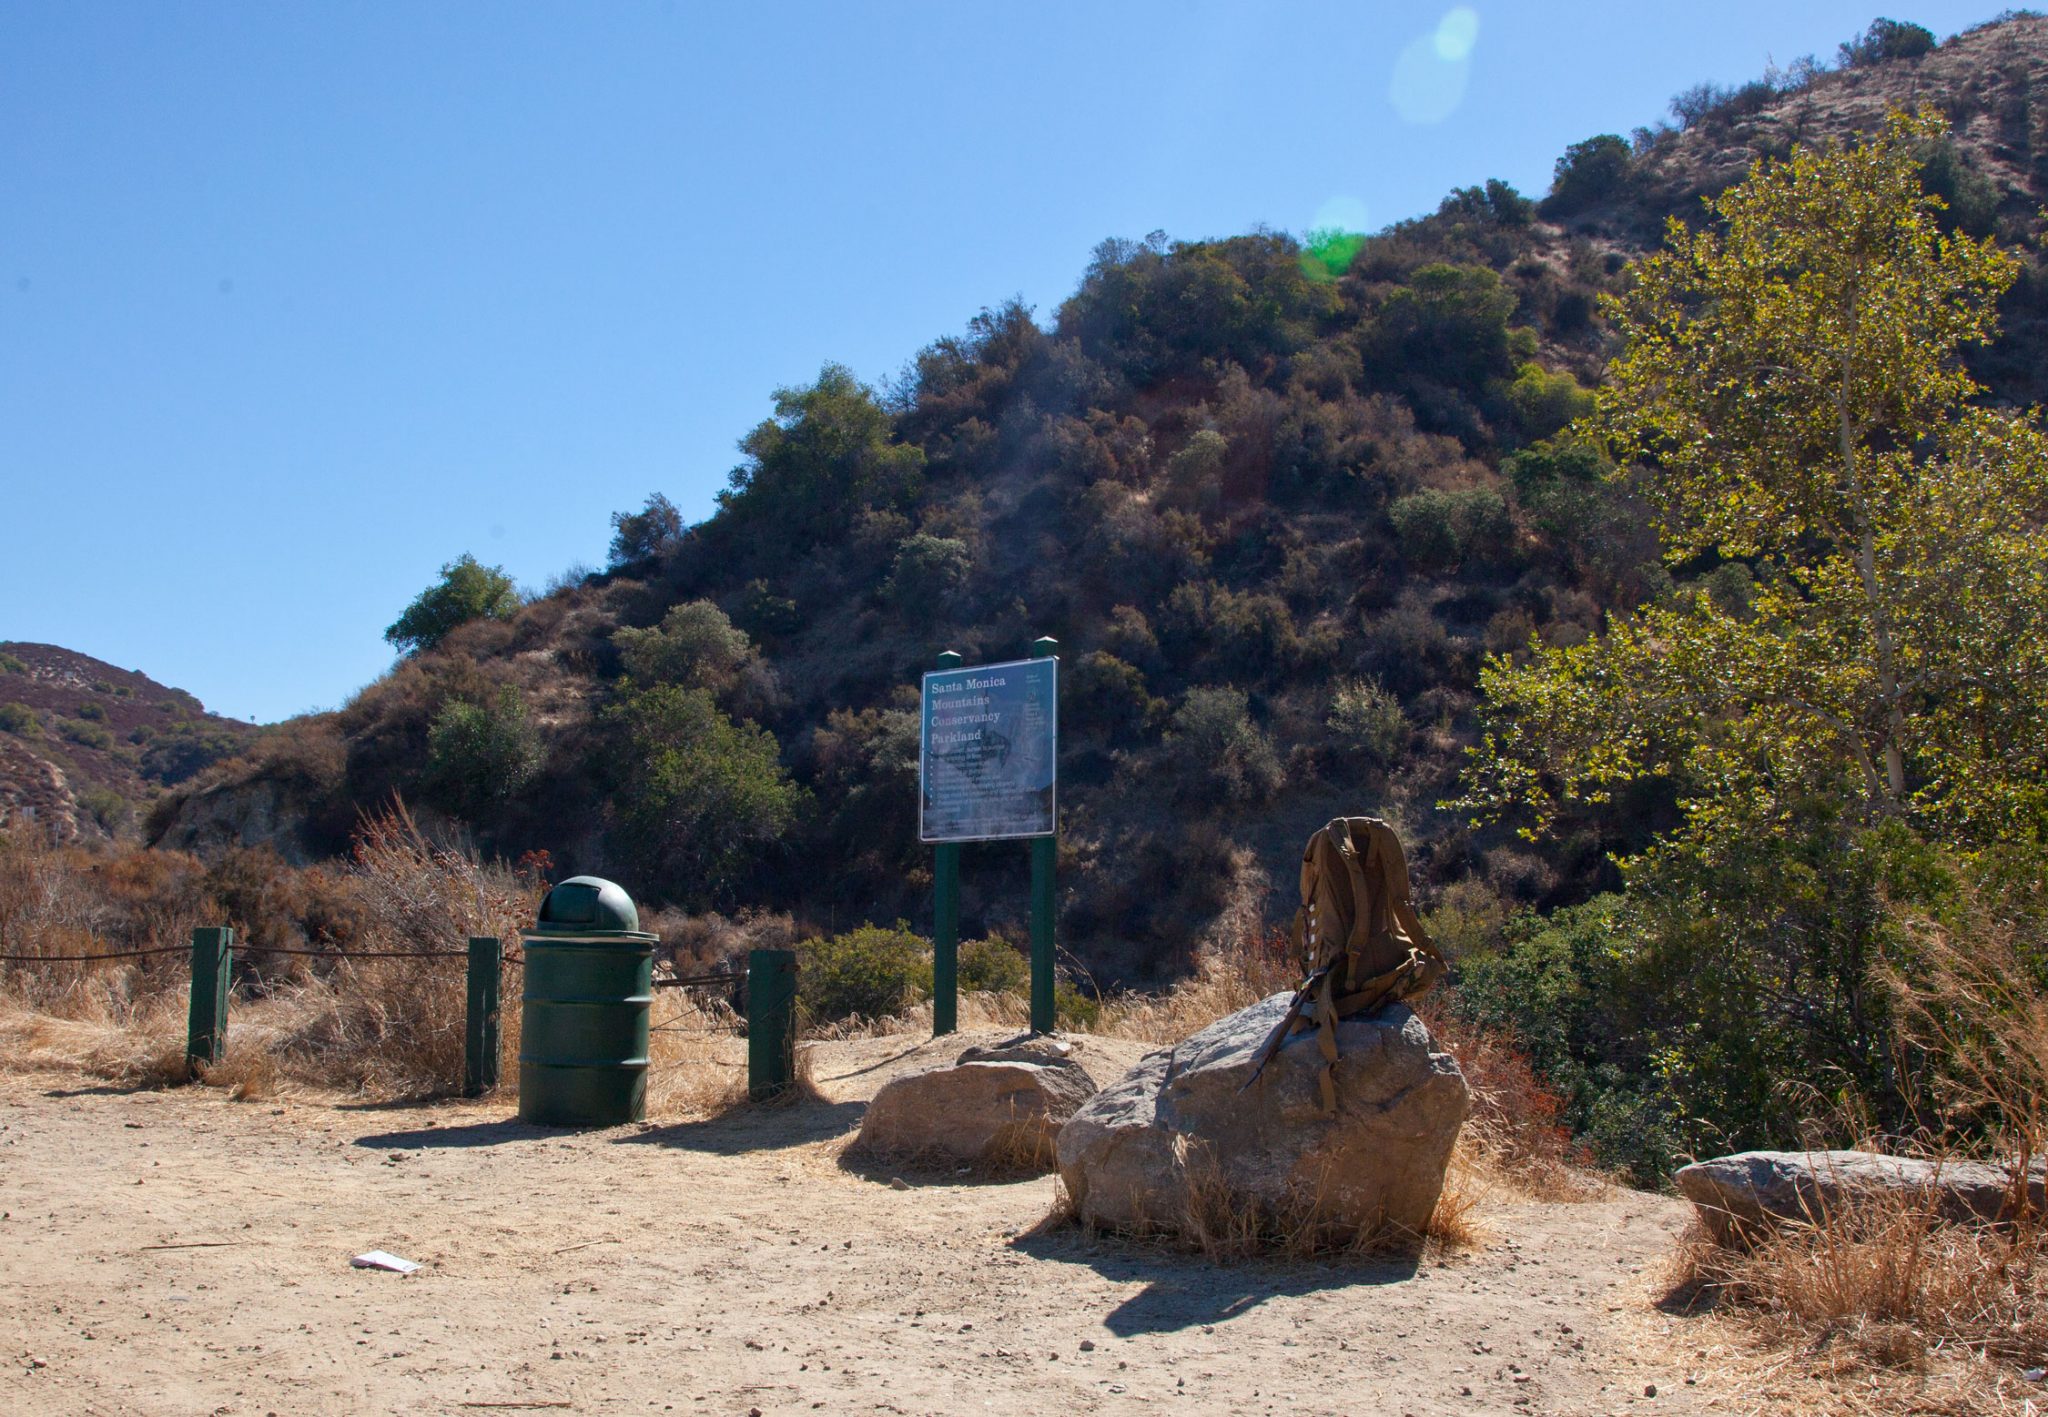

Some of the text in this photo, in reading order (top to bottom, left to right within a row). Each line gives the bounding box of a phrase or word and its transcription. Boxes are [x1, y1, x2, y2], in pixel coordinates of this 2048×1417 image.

[931, 677, 1006, 694] Santa Monica
[932, 696, 990, 711] Mountains
[931, 712, 1001, 728] Conservancy
[931, 729, 981, 745] Parkland
